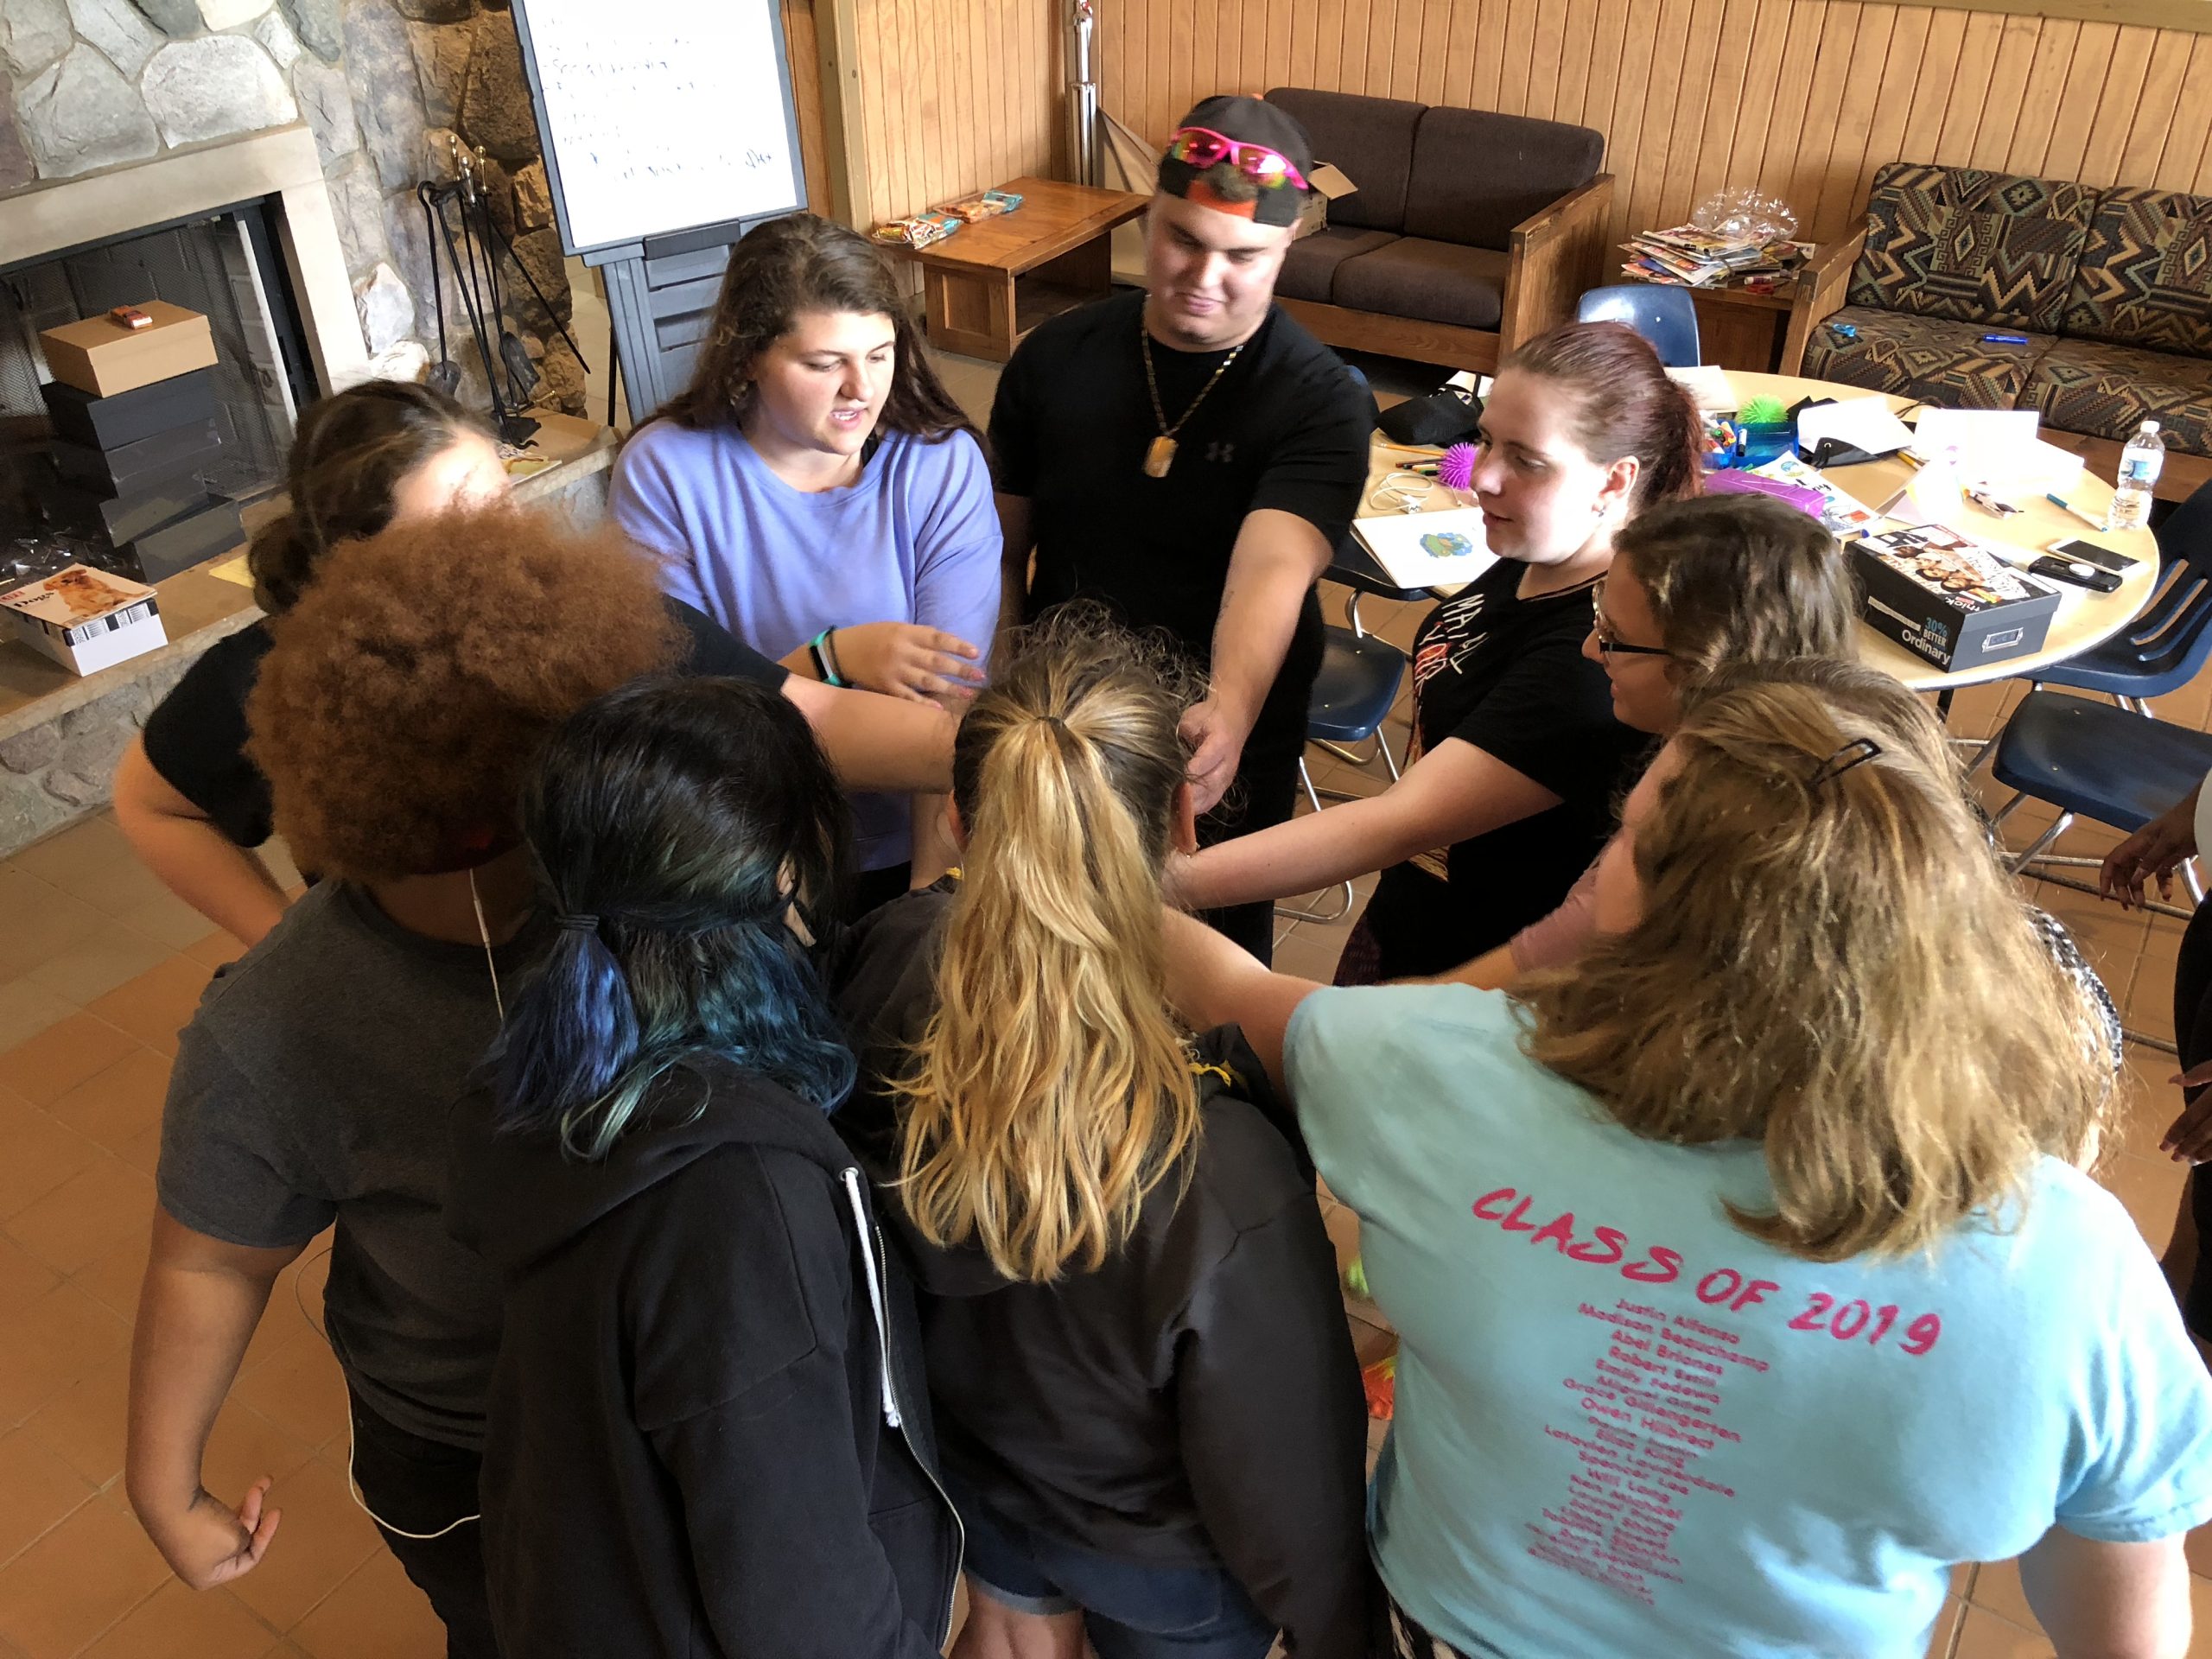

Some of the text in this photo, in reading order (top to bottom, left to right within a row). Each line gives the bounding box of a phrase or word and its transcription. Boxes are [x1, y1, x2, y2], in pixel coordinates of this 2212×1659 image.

[1923, 628, 1947, 647] BETTER
[1924, 617, 1948, 638] 30%
[1901, 629, 1951, 665] Ordinary
[1472, 1188, 1942, 1357] CLASS OF 2019
